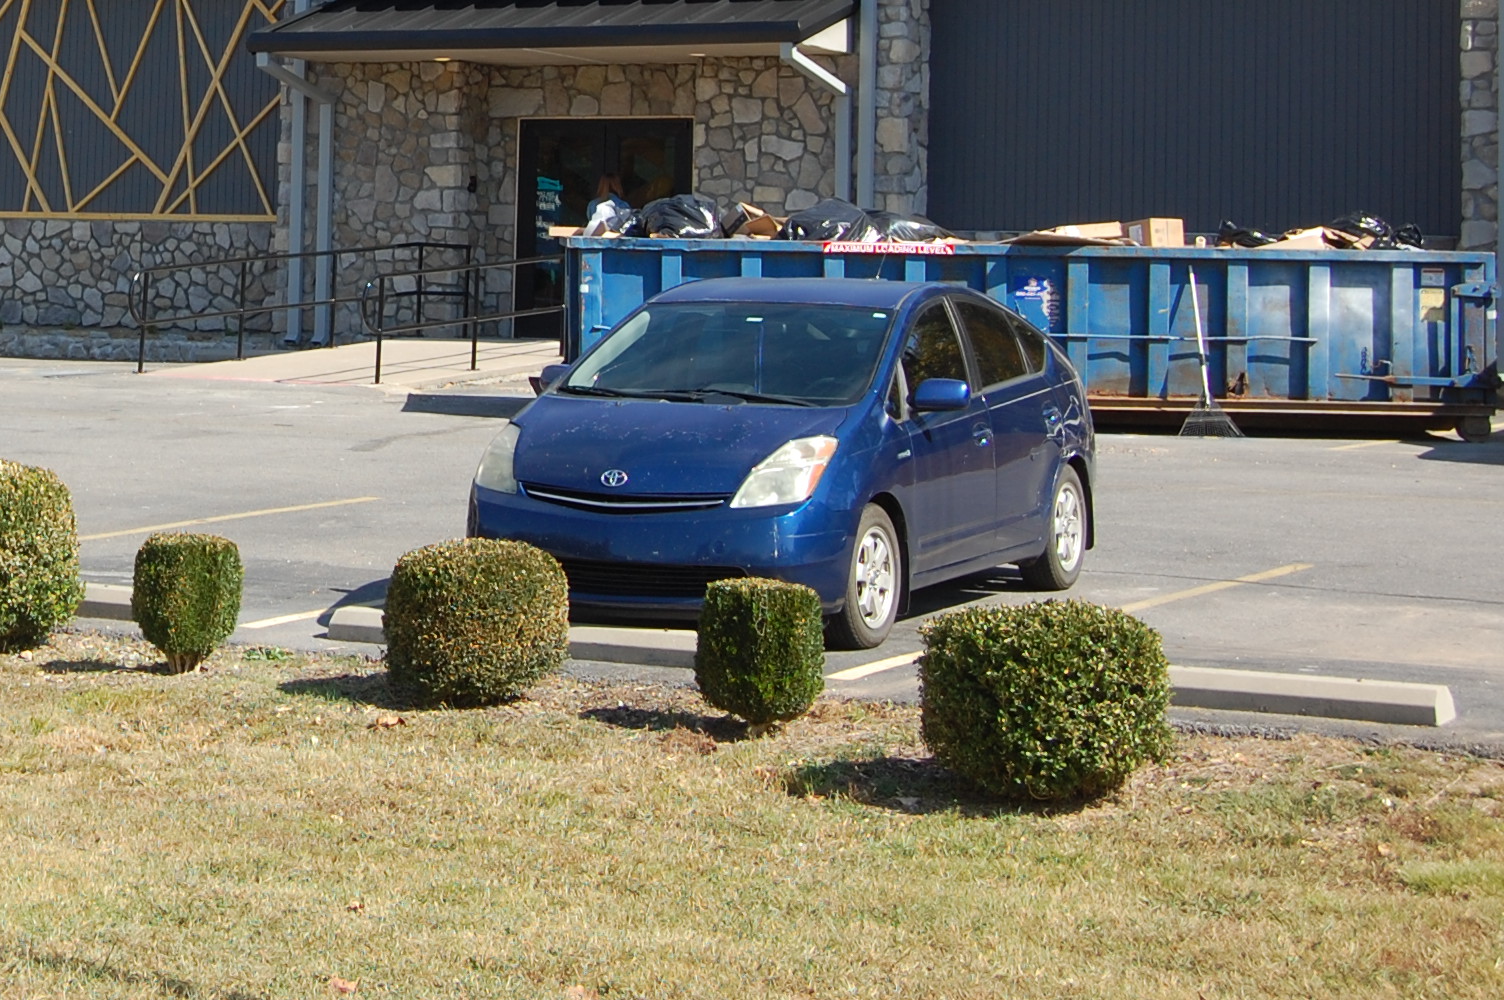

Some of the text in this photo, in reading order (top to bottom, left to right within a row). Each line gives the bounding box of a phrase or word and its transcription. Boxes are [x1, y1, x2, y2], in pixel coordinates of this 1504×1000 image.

[830, 244, 945, 255] MAXIMUM LOADING LEVEL
